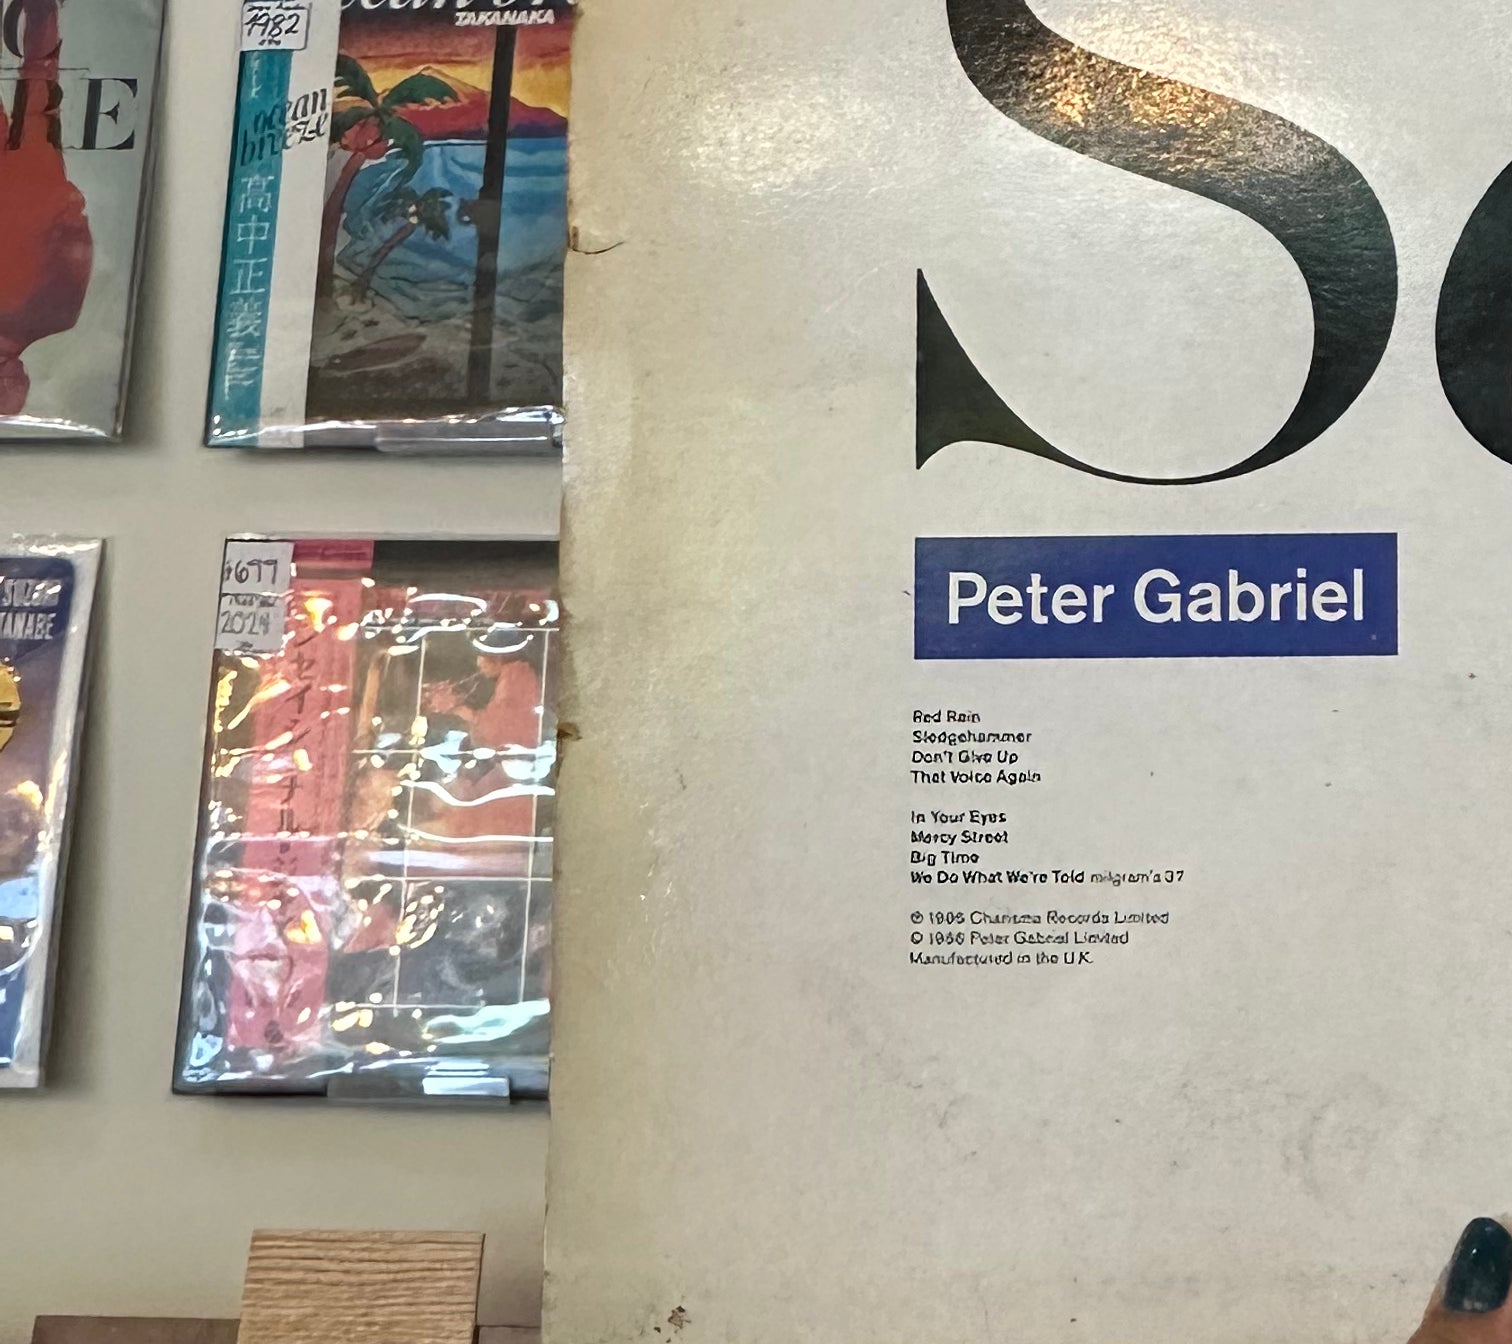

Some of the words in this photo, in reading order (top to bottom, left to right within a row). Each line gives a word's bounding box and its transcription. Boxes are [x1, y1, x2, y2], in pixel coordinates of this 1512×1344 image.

[453, 8, 556, 27] TAKANAKA
[947, 571, 1114, 625] Peter
[1133, 567, 1364, 623] Gabriel
[912, 710, 941, 723] Red
[946, 710, 981, 723] Rain
[912, 730, 1033, 746] Sledgehammer
[911, 750, 953, 764] Don't
[958, 750, 992, 764] Give
[997, 750, 1019, 765] Up
[910, 770, 946, 784] That
[950, 770, 992, 784] Voice
[996, 770, 1042, 786] Again
[911, 810, 926, 824] In
[930, 810, 965, 824] Your
[969, 810, 1008, 827] Eyes
[910, 830, 957, 846] Mercy
[960, 830, 1009, 844] Street
[910, 850, 937, 866] Big
[941, 850, 980, 865] Time
[911, 870, 932, 884] We
[937, 870, 959, 884] Do
[962, 870, 1003, 884] What
[1006, 870, 1048, 884] We're
[1051, 869, 1085, 884] Told
[1164, 870, 1184, 884] 37
[1046, 910, 1110, 924] Records
[1114, 910, 1169, 924] Limited
[969, 931, 1009, 944] Peter
[1013, 931, 1069, 945] Gabriel
[1074, 930, 1130, 944] Limited
[909, 952, 1014, 966] Manufactured
[1017, 952, 1031, 965] in
[1036, 951, 1058, 965] the
